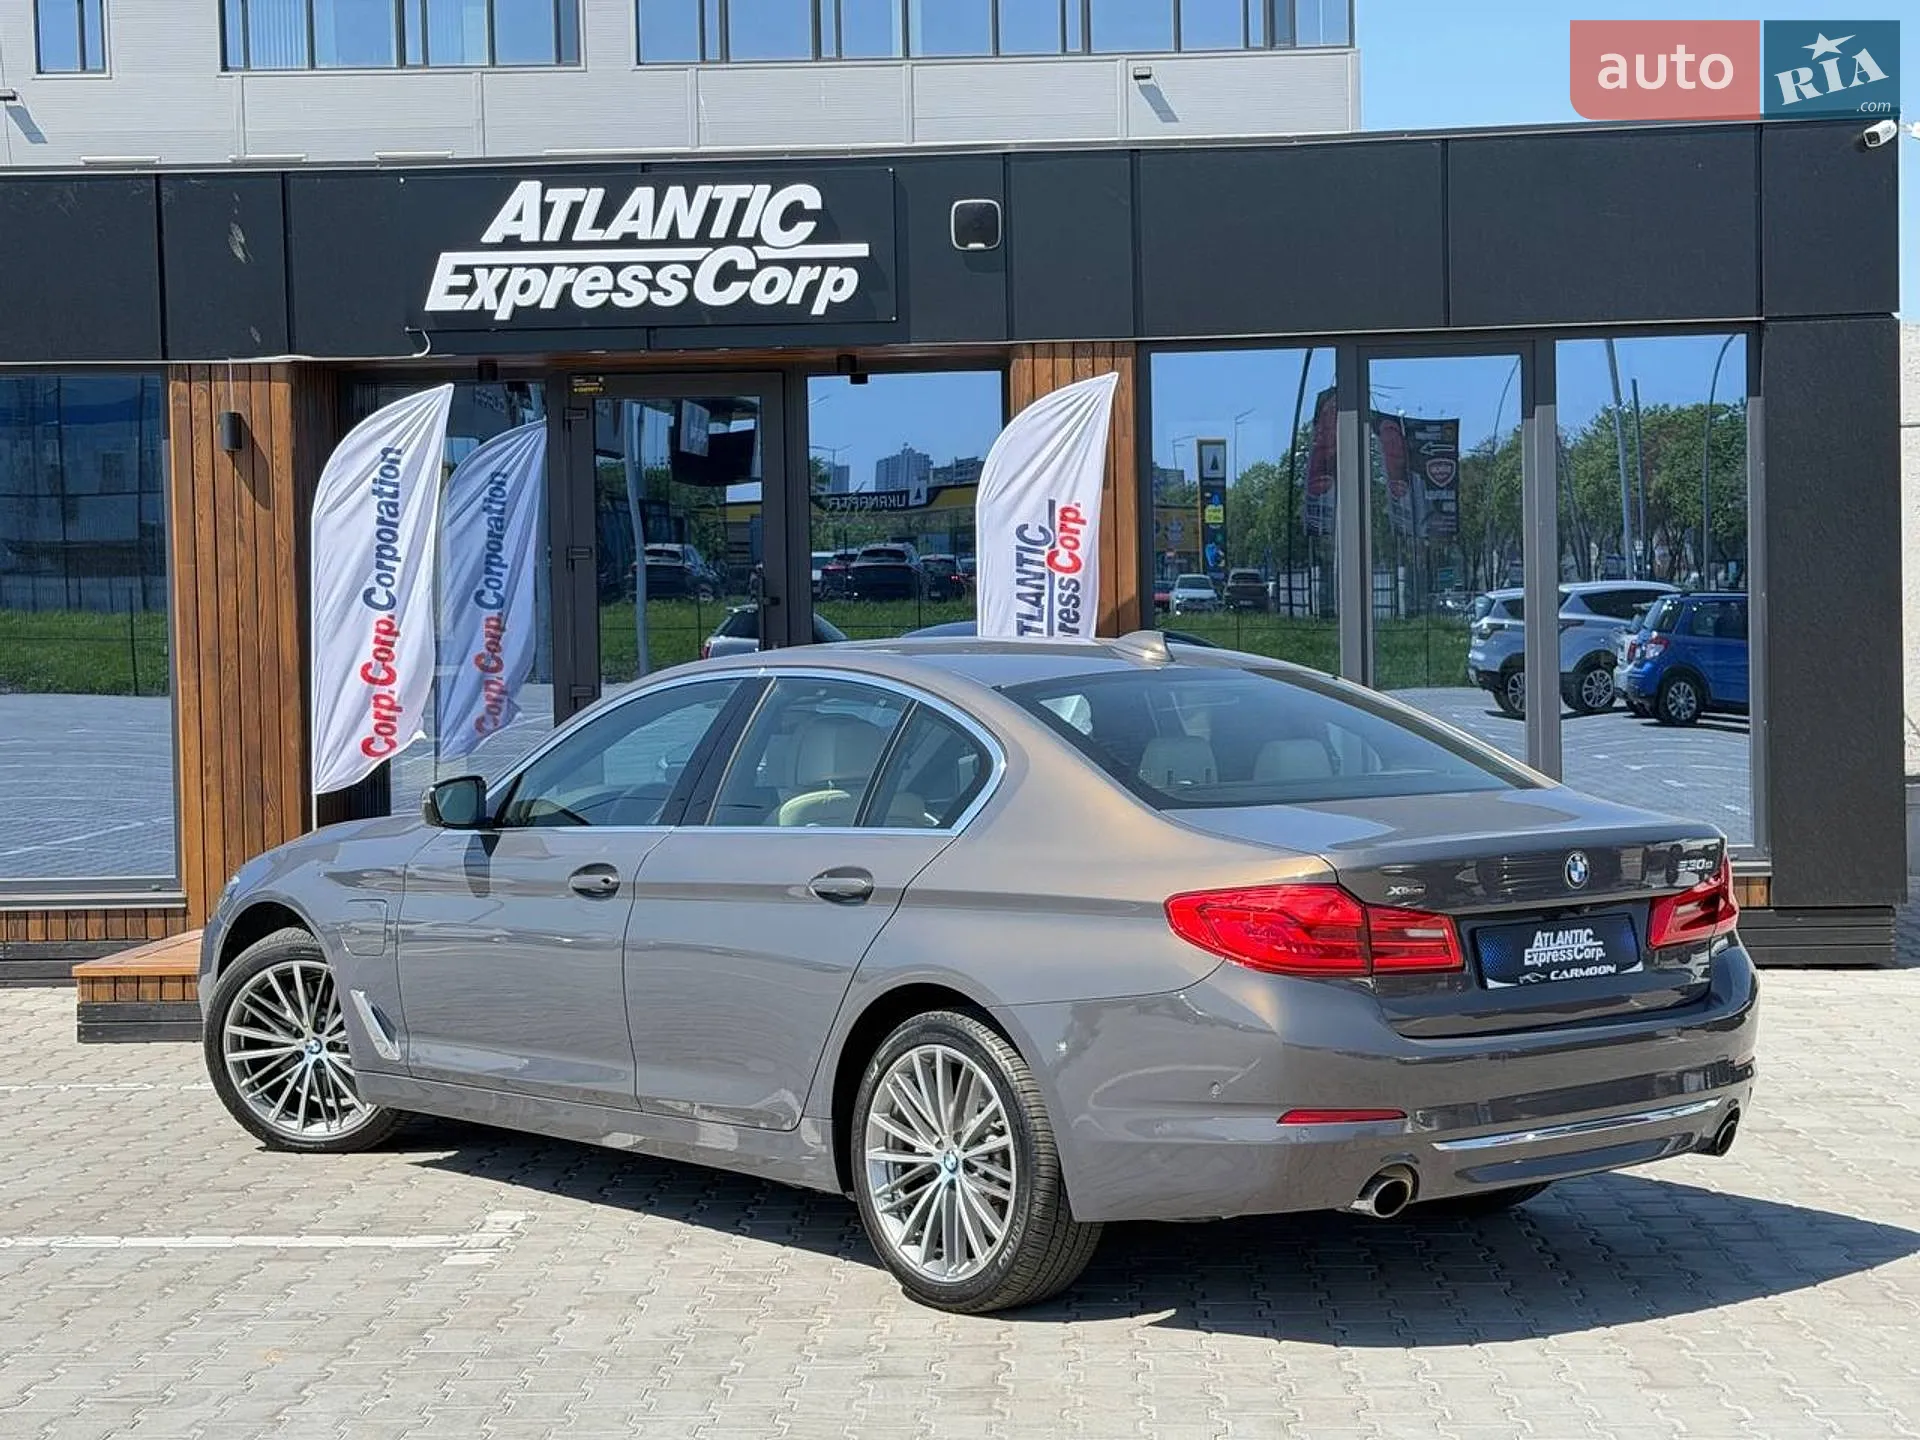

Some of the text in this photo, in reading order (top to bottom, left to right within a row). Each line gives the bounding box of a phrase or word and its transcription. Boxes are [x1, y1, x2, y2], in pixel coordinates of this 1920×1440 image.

[480, 180, 822, 247] ATLANTIC
[424, 246, 859, 321] ExpressCorp
[1015, 523, 1051, 636] TLANTIC
[1046, 501, 1087, 637] ressCorp.
[1532, 928, 1593, 948] ATLANTIC
[1550, 964, 1617, 980] CARMOON
